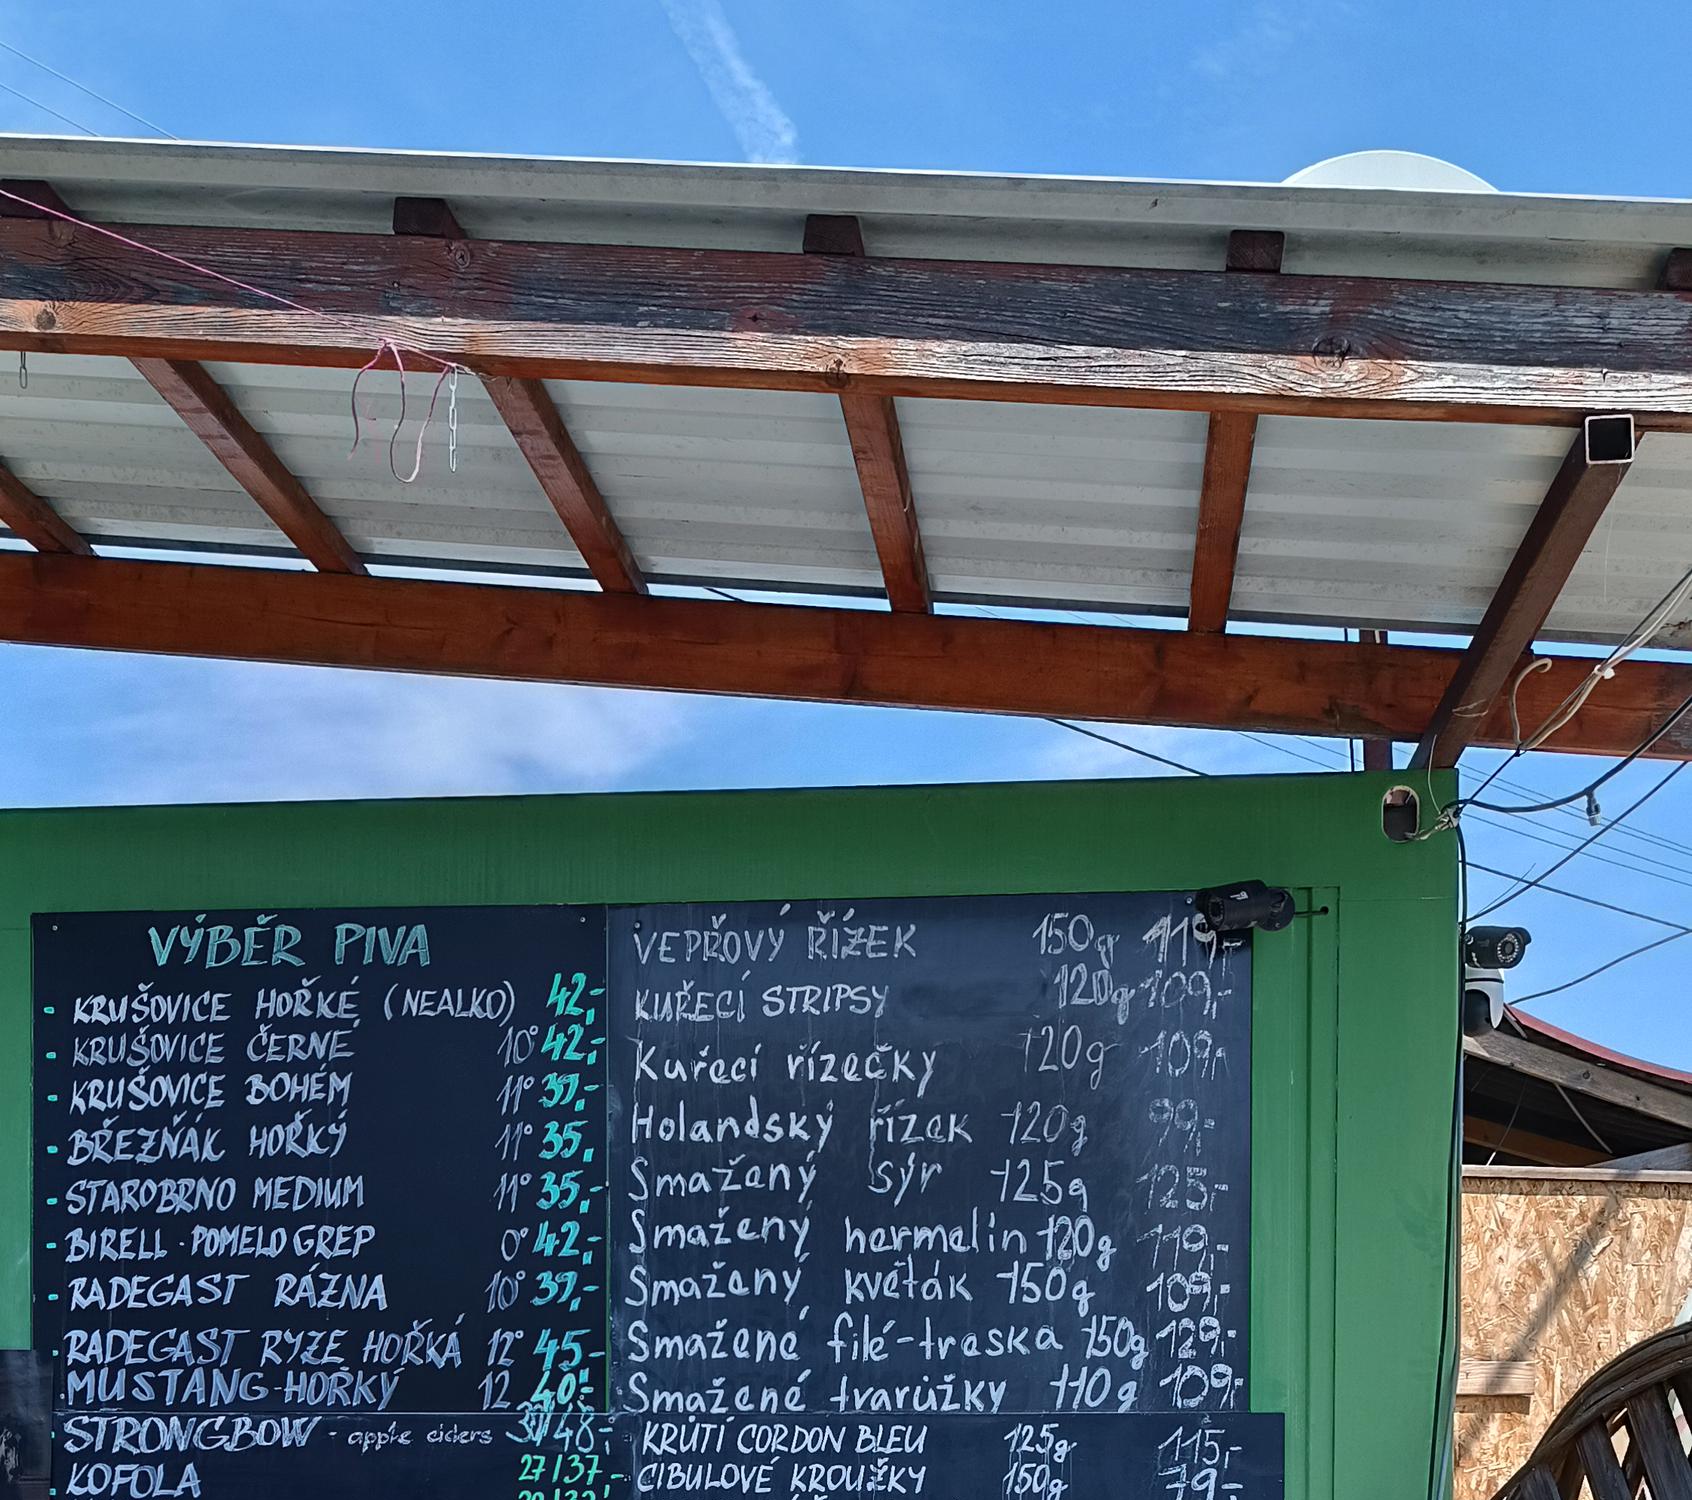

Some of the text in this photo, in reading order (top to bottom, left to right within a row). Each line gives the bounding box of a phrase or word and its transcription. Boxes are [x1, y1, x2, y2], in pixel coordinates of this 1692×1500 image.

[148, 914, 430, 968] VÝBĚR PIVA
[633, 903, 916, 964] VEPŘOVÝ ŘÍZEK
[73, 982, 232, 1025] KRUŠOVICE
[255, 975, 360, 1019] HOŘKÉ
[384, 981, 515, 1027] (NEALKO)
[635, 970, 889, 1023] KUŘECÍ STRIPSY
[73, 1019, 360, 1067] KRUŠOVICE ČERNÉ
[69, 1063, 353, 1115] KRUŠOVICE BOHÉM
[635, 1040, 936, 1099] Kuřecí řízečky
[249, 1108, 347, 1158] HOŘKÝ
[631, 1094, 972, 1152] Holandský řízek
[65, 1176, 364, 1215] STAROBRNO MEDIUM
[628, 1150, 817, 1203] Smažený
[64, 1224, 378, 1263] BIRELL POMELO GREP
[629, 1200, 812, 1258] Smažený
[67, 1272, 250, 1311] RADEGAST
[625, 1252, 810, 1306] Smažený
[844, 1254, 973, 1304] květák
[64, 1328, 250, 1367] RADEGAST
[363, 1313, 465, 1369] HOŘKÁ
[627, 1306, 810, 1362] Smažené
[623, 1368, 1007, 1414] Smažené tvarůžky
[64, 1416, 322, 1454] STRONGBOW
[427, 1423, 492, 1444] ciders
[642, 1416, 735, 1455] KRŮTÍ
[737, 1423, 846, 1454] CORDON
[855, 1424, 928, 1454] BLEU
[66, 1462, 201, 1499] KOFOLA
[637, 1455, 927, 1494] CIBULOVÉ KROUŽKY
